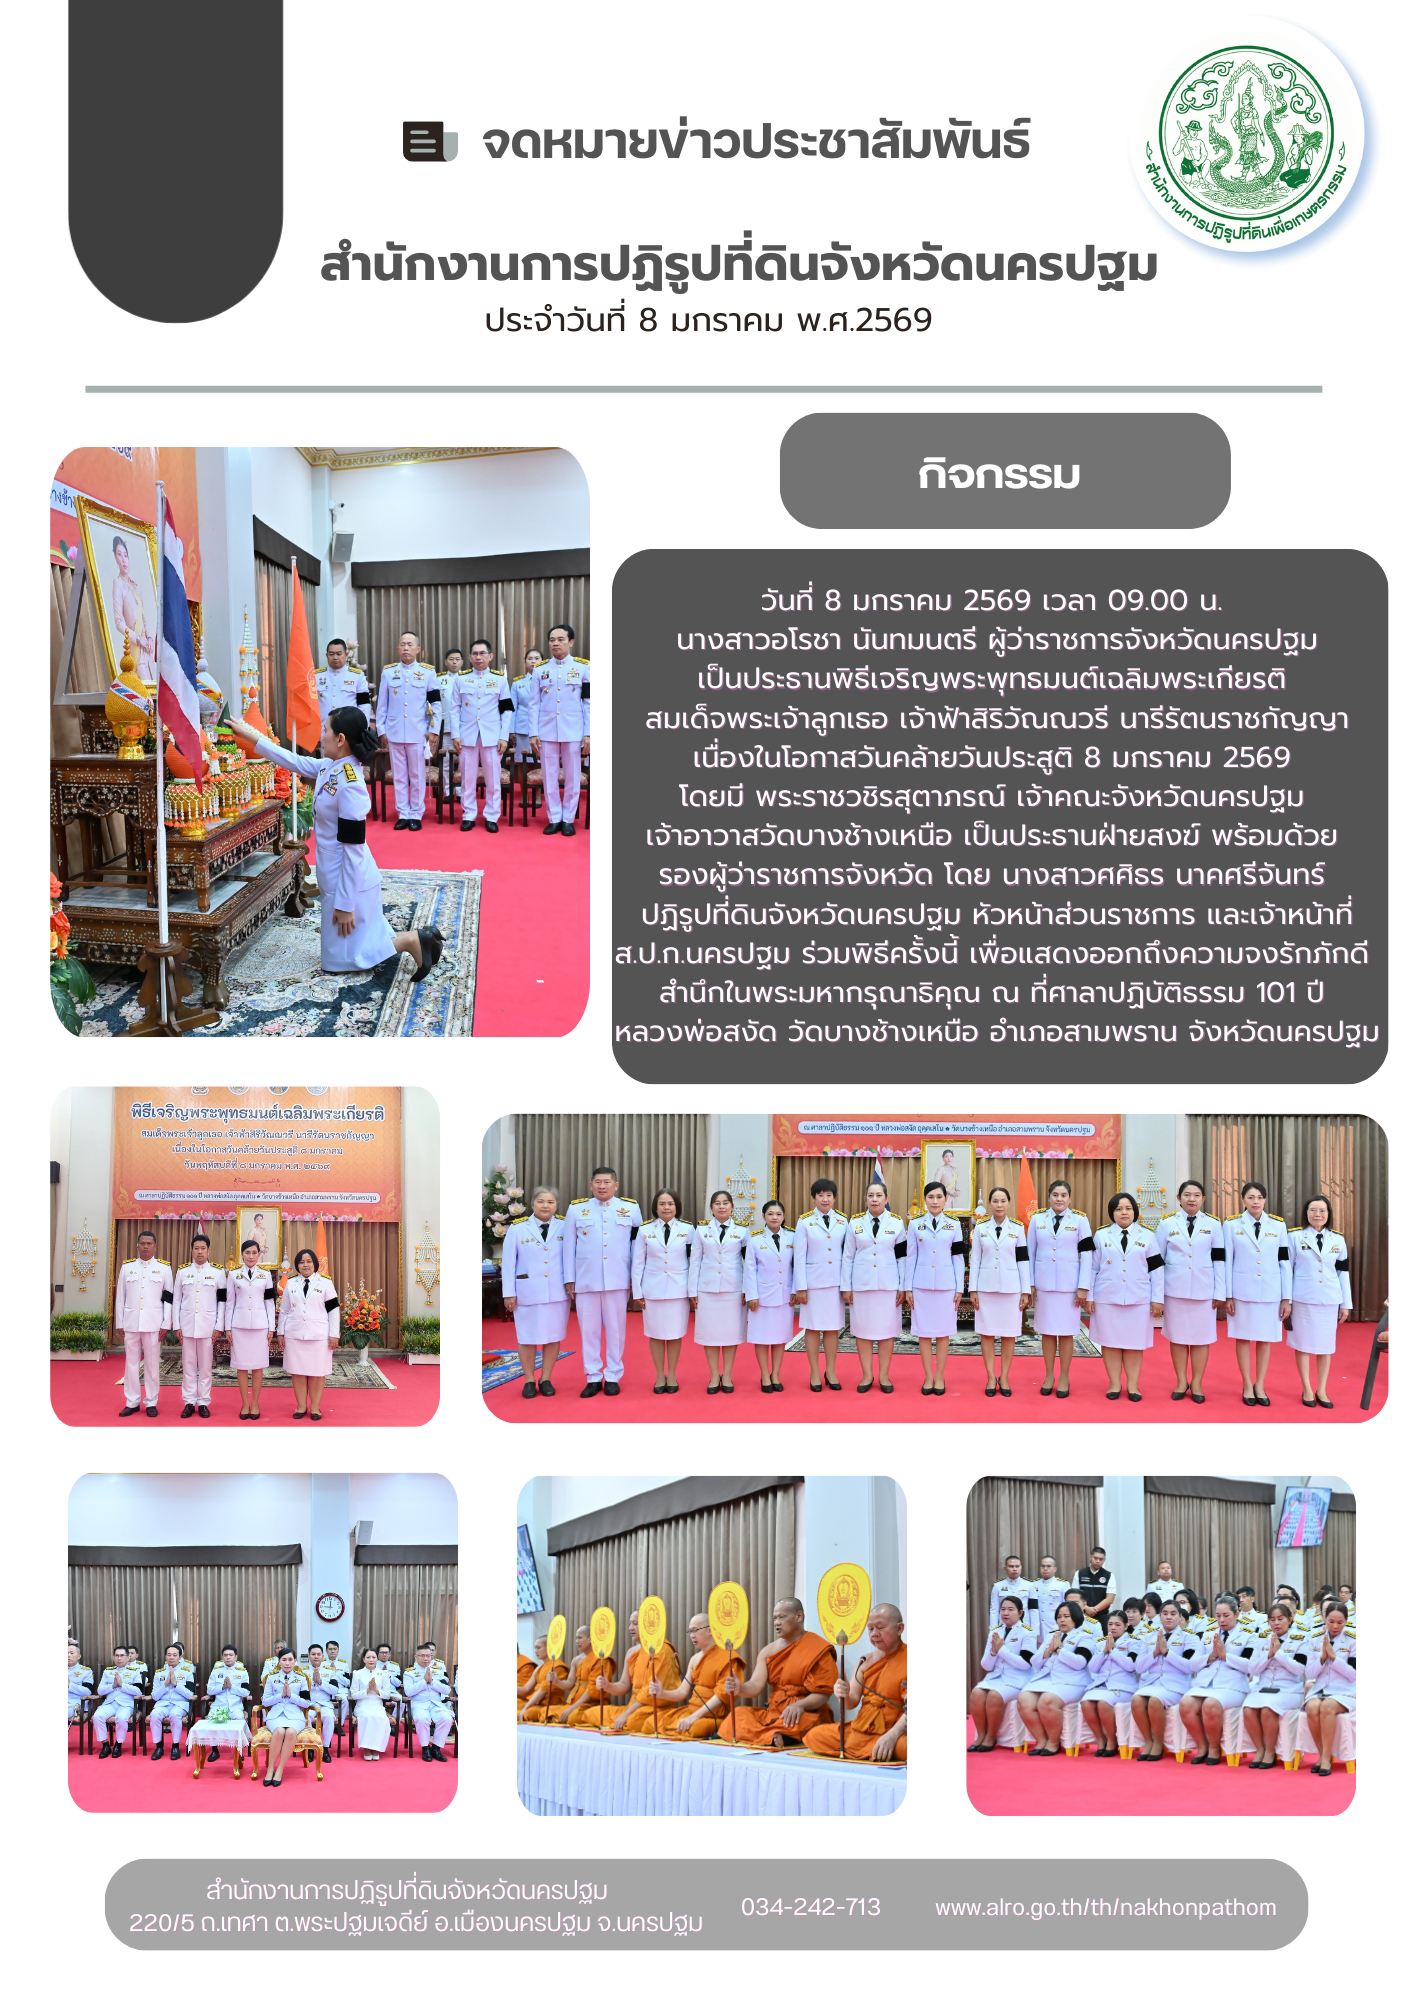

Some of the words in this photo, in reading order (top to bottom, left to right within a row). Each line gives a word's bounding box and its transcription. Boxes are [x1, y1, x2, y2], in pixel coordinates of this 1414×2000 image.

[131, 1103, 385, 1124] พิธีเจริญพระพุทธมนต์เฉลิมพระเกียรติ
